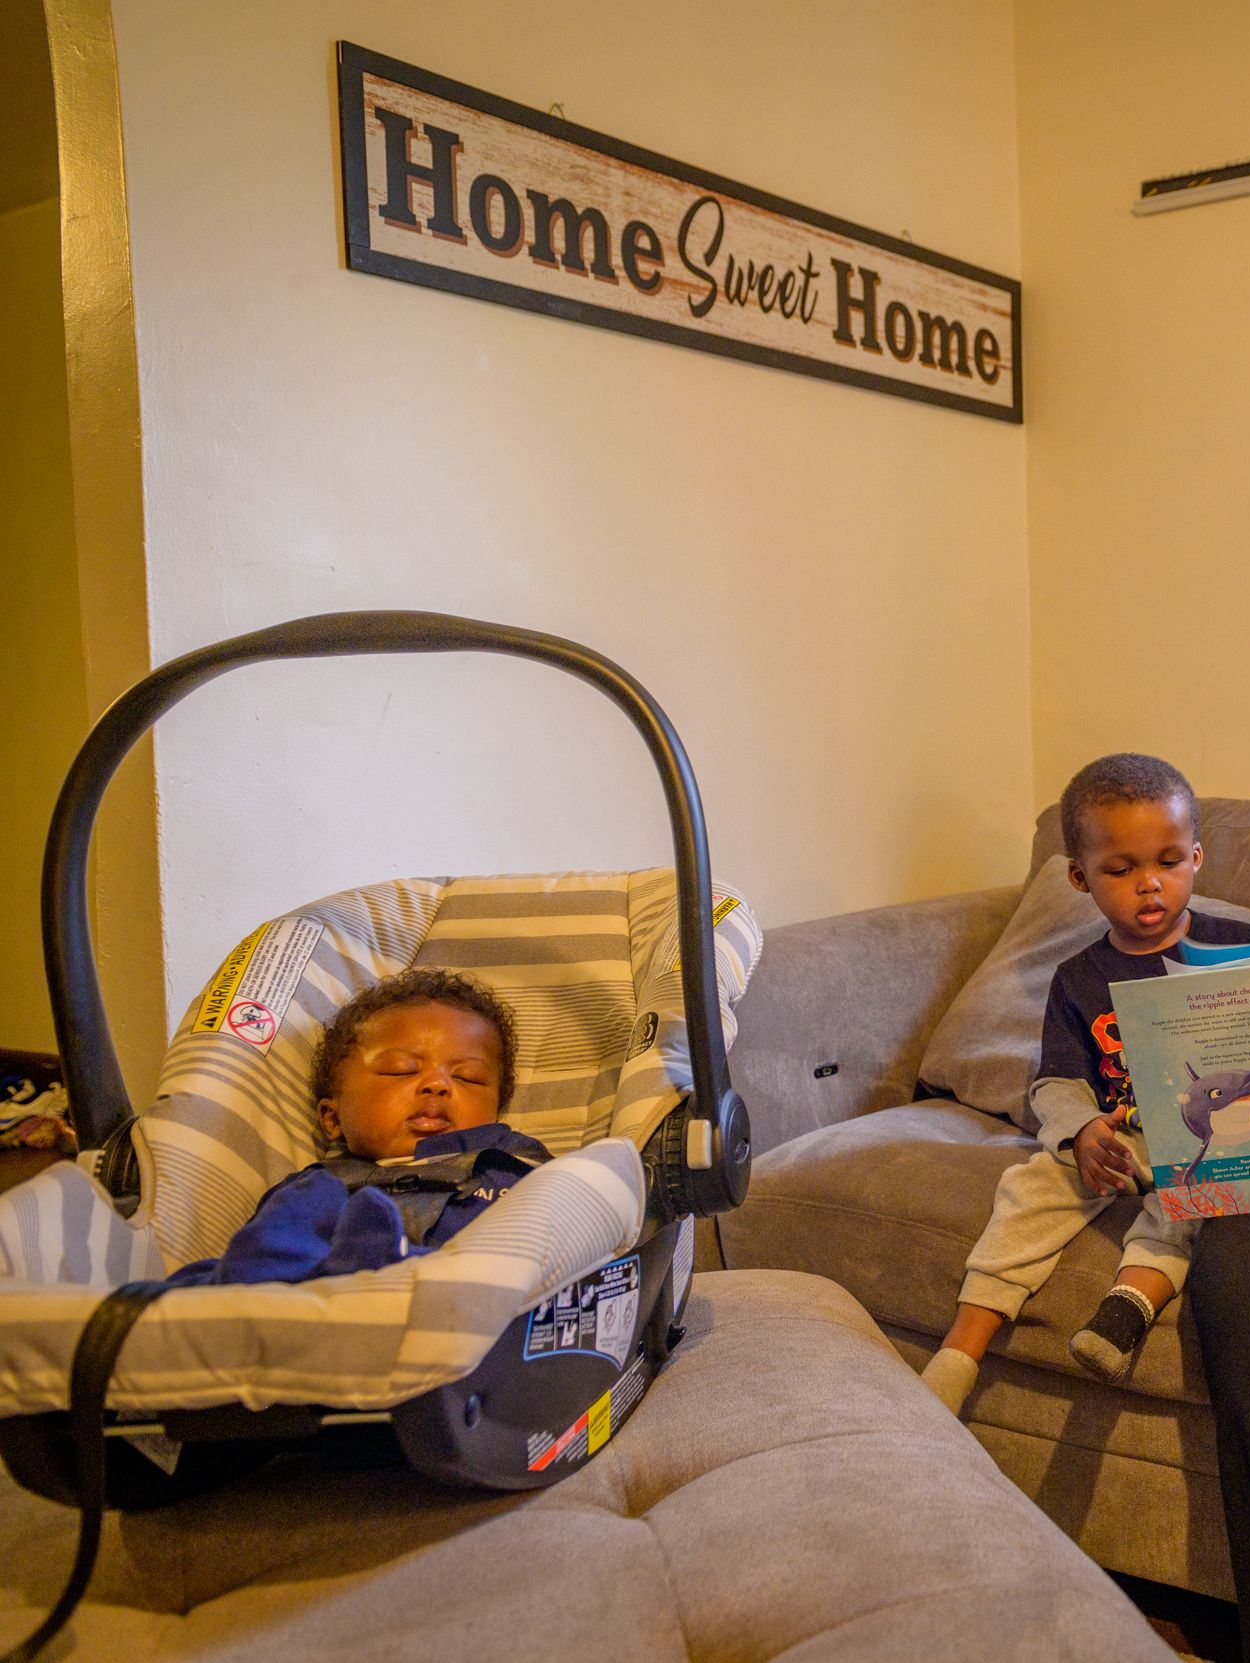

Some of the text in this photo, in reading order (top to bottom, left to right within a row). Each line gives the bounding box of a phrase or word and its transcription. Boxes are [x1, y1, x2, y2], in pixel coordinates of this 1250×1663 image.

[375, 107, 1000, 386] Home Sweet Home
[206, 969, 239, 1014] WARNING
[1186, 994, 1193, 1002] A
[1195, 991, 1215, 1002] story
[1217, 988, 1238, 998] about
[1189, 1002, 1202, 1011] the
[1203, 998, 1225, 1011] ripple
[1226, 996, 1248, 1007] effect
